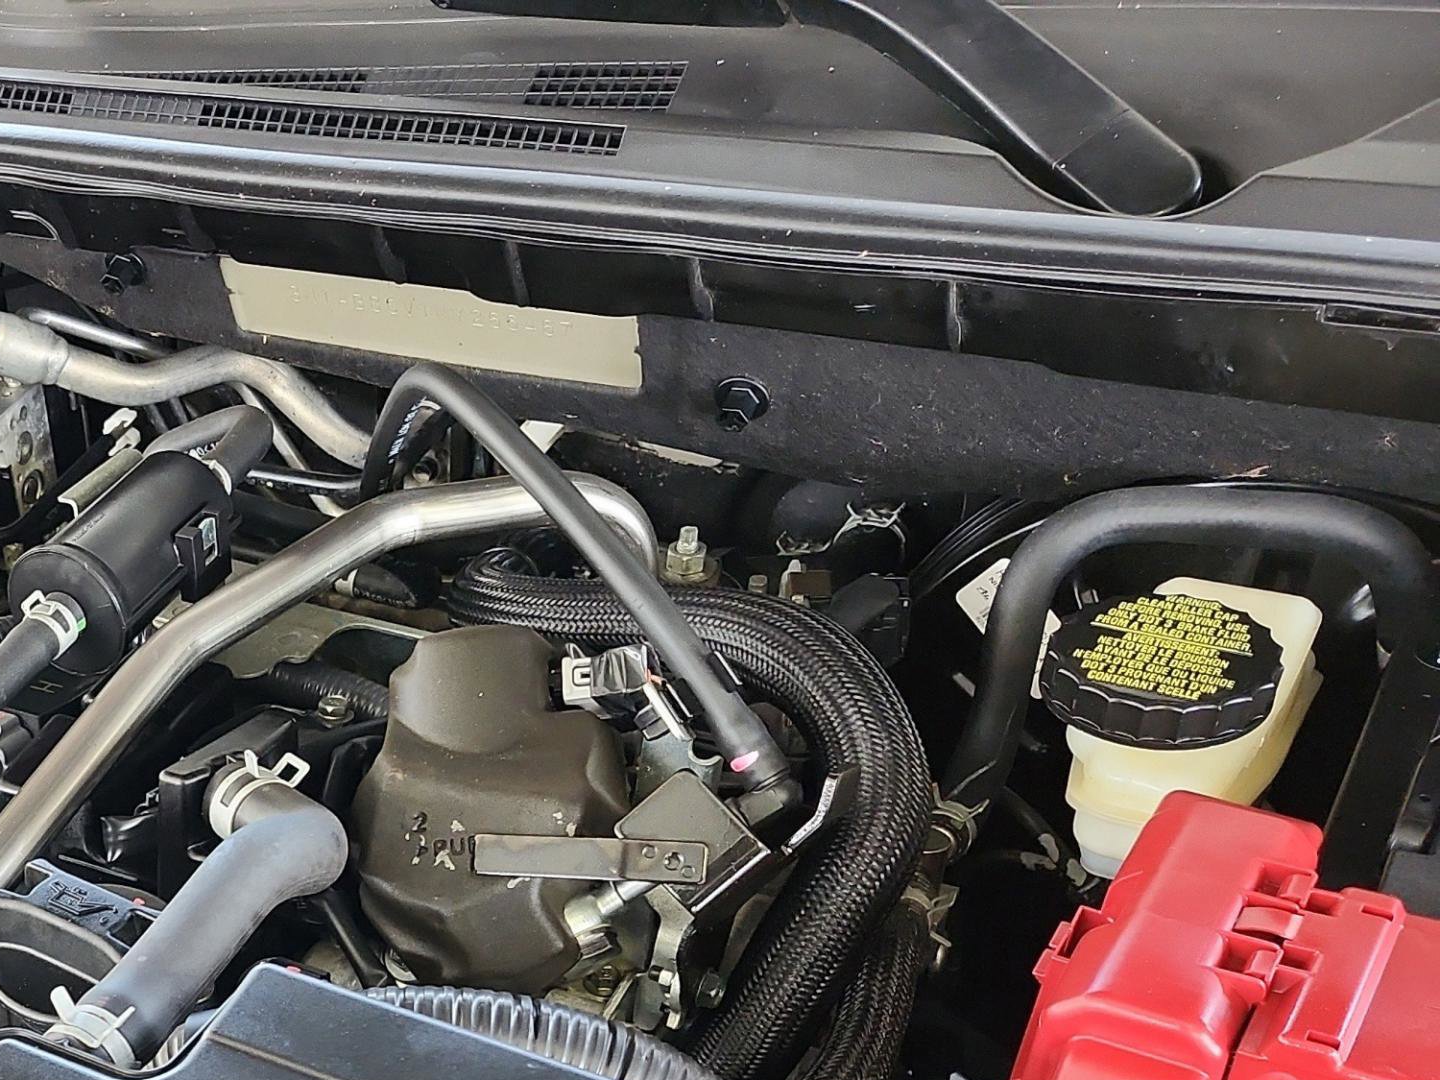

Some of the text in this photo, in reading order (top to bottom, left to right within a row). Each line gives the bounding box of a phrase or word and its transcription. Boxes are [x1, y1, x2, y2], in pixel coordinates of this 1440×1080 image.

[1107, 607, 1251, 642] ONLY DOT 3 BRAKE FLUID
[1117, 601, 1161, 616] BEFORE
[1225, 622, 1249, 633] USE
[1136, 596, 1239, 622] CLEAN FILLER CAP
[1094, 613, 1130, 627] FROM
[1128, 621, 1139, 629] A
[1140, 623, 1185, 638] SEALED
[1071, 648, 1236, 688] N'EMPLOYER QUE DU LIQUIDE
[1093, 643, 1135, 658] AVANT
[1134, 652, 1153, 662] DE
[1152, 656, 1170, 665] LE
[1096, 635, 1230, 669] NETTOYER LE BOUCHON
[1080, 659, 1218, 694] DOT 3 PROVENANT D'UN
[1086, 669, 1157, 690] CONTENANT
